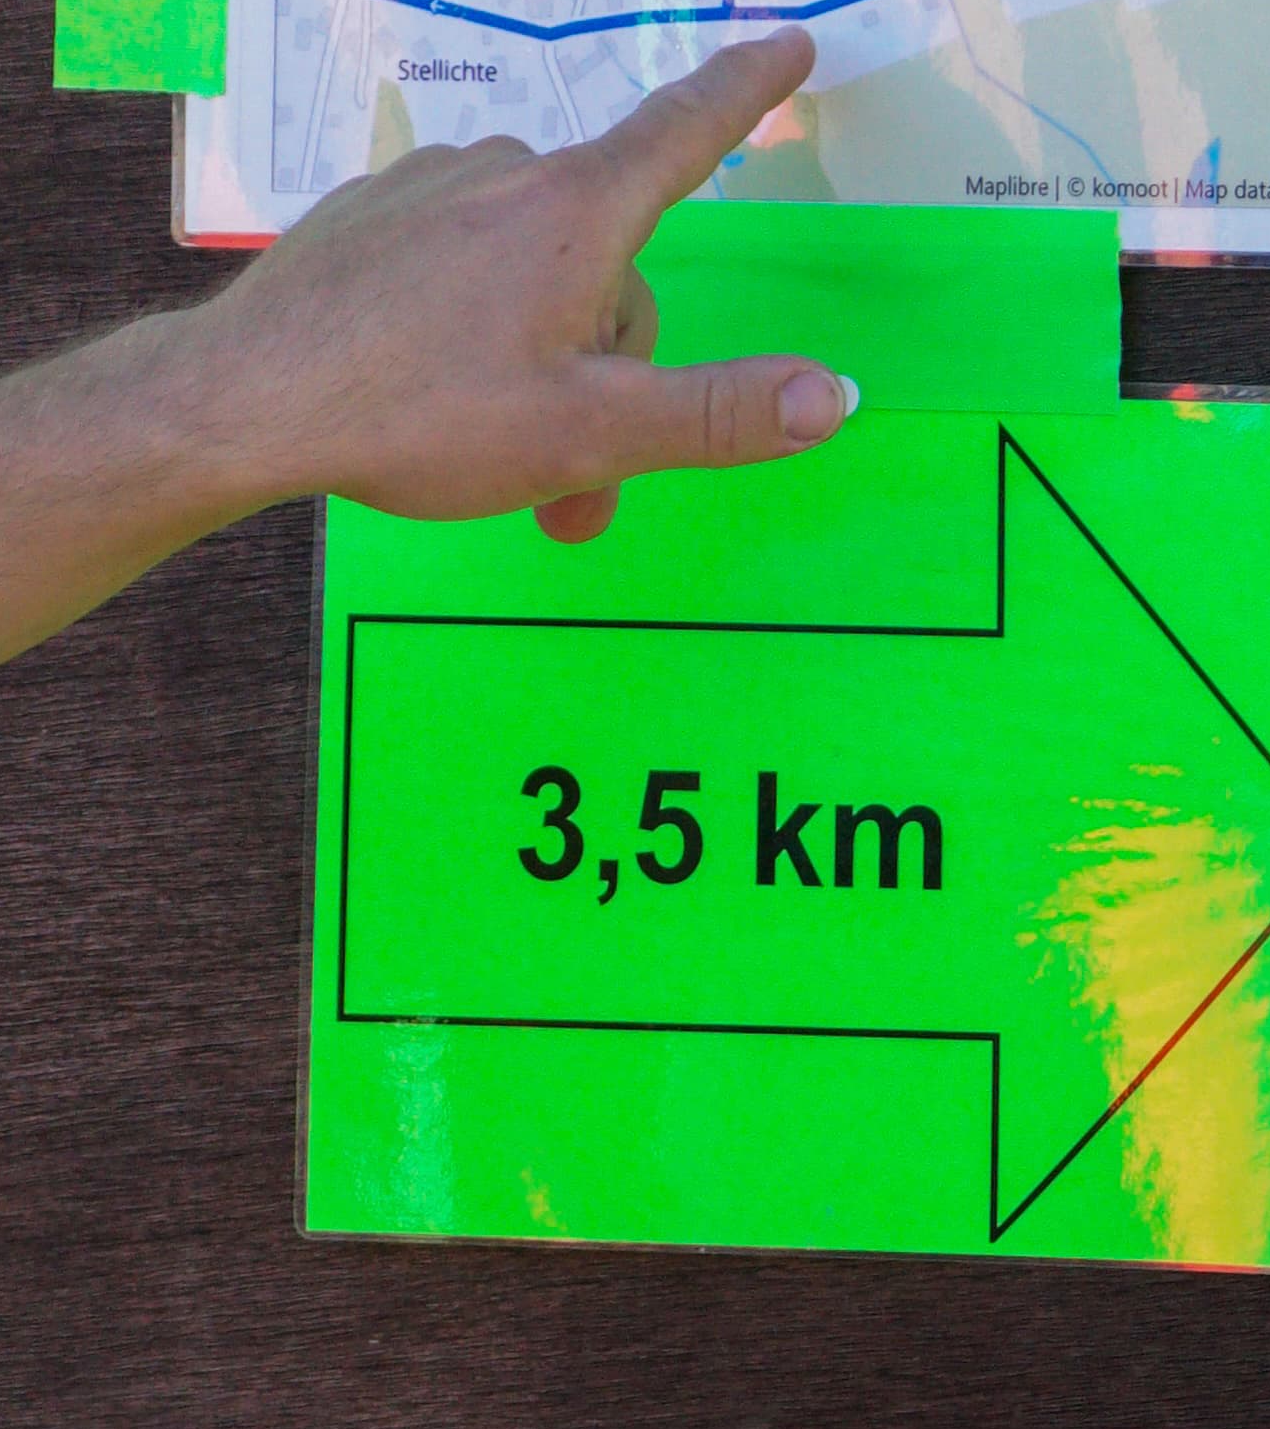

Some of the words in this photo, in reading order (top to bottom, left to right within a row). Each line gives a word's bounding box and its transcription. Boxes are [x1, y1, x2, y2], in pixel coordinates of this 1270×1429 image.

[397, 58, 499, 83] Stellichte
[965, 175, 1050, 204] Maplibre
[1092, 176, 1169, 199] komoot
[1185, 179, 1229, 204] Map
[515, 765, 706, 907] 3,5
[753, 770, 945, 891] km
